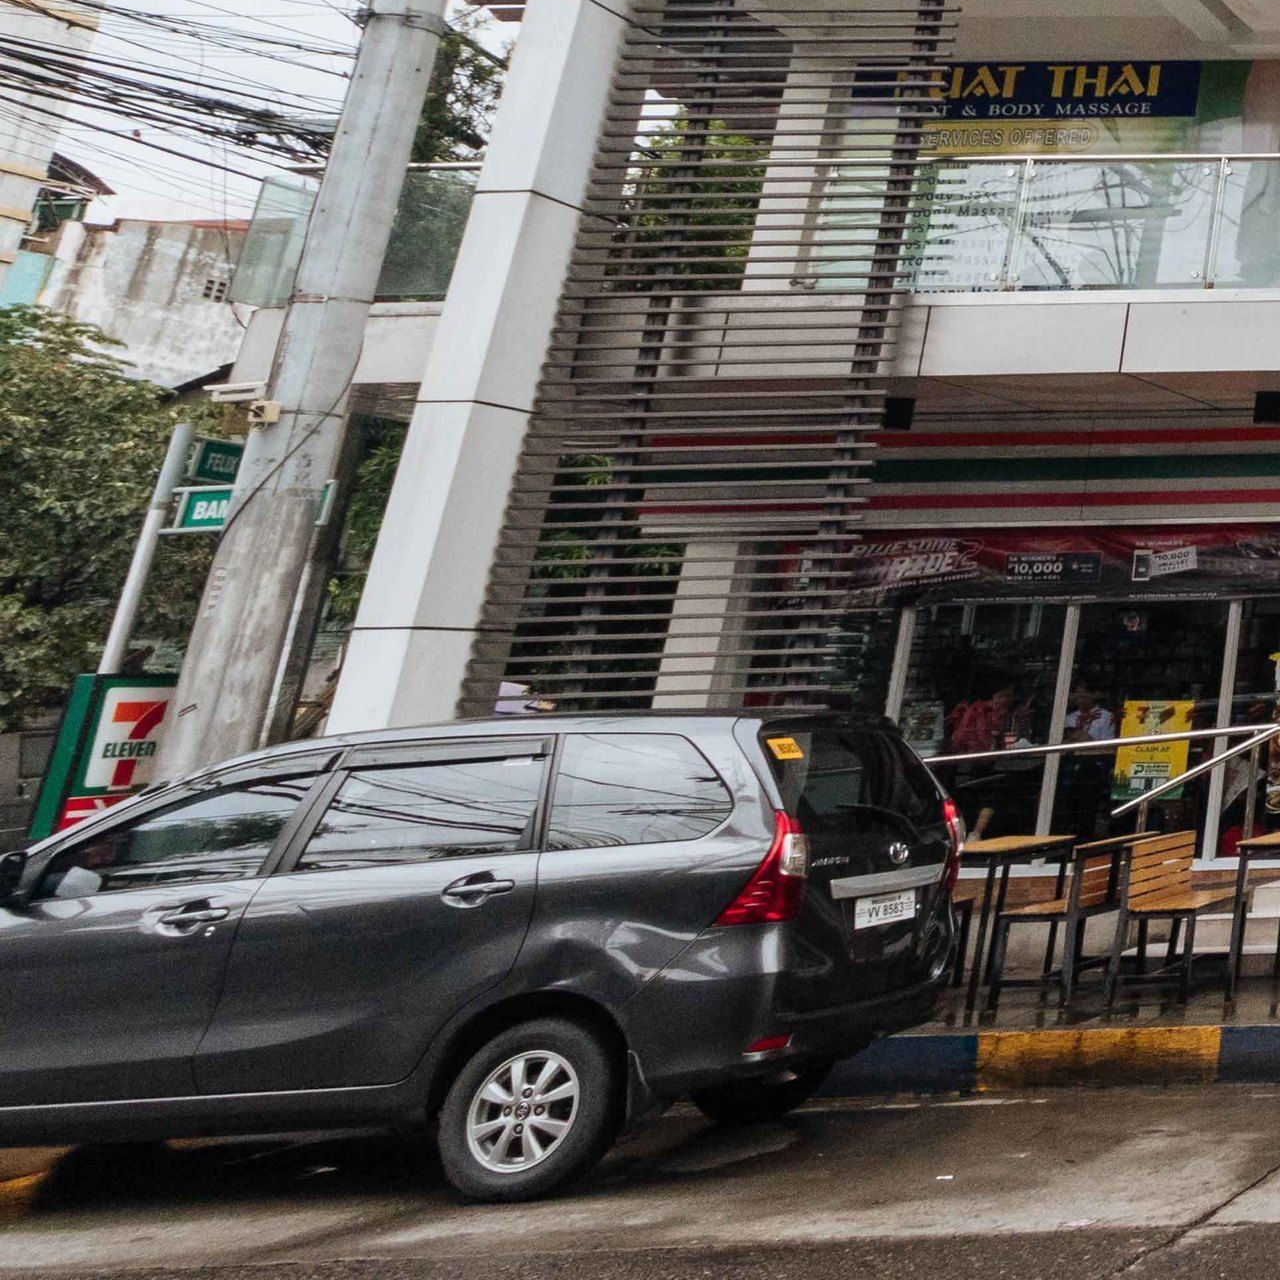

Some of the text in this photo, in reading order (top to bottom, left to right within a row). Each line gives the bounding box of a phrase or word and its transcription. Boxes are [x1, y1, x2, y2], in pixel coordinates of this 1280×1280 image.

[1047, 63, 1162, 98] THAI
[961, 104, 978, 117] &
[987, 103, 1045, 117] BODY
[1055, 102, 1152, 116] MASSAGE
[1010, 125, 1092, 146] OFFERED
[867, 902, 906, 919] VV 8583
